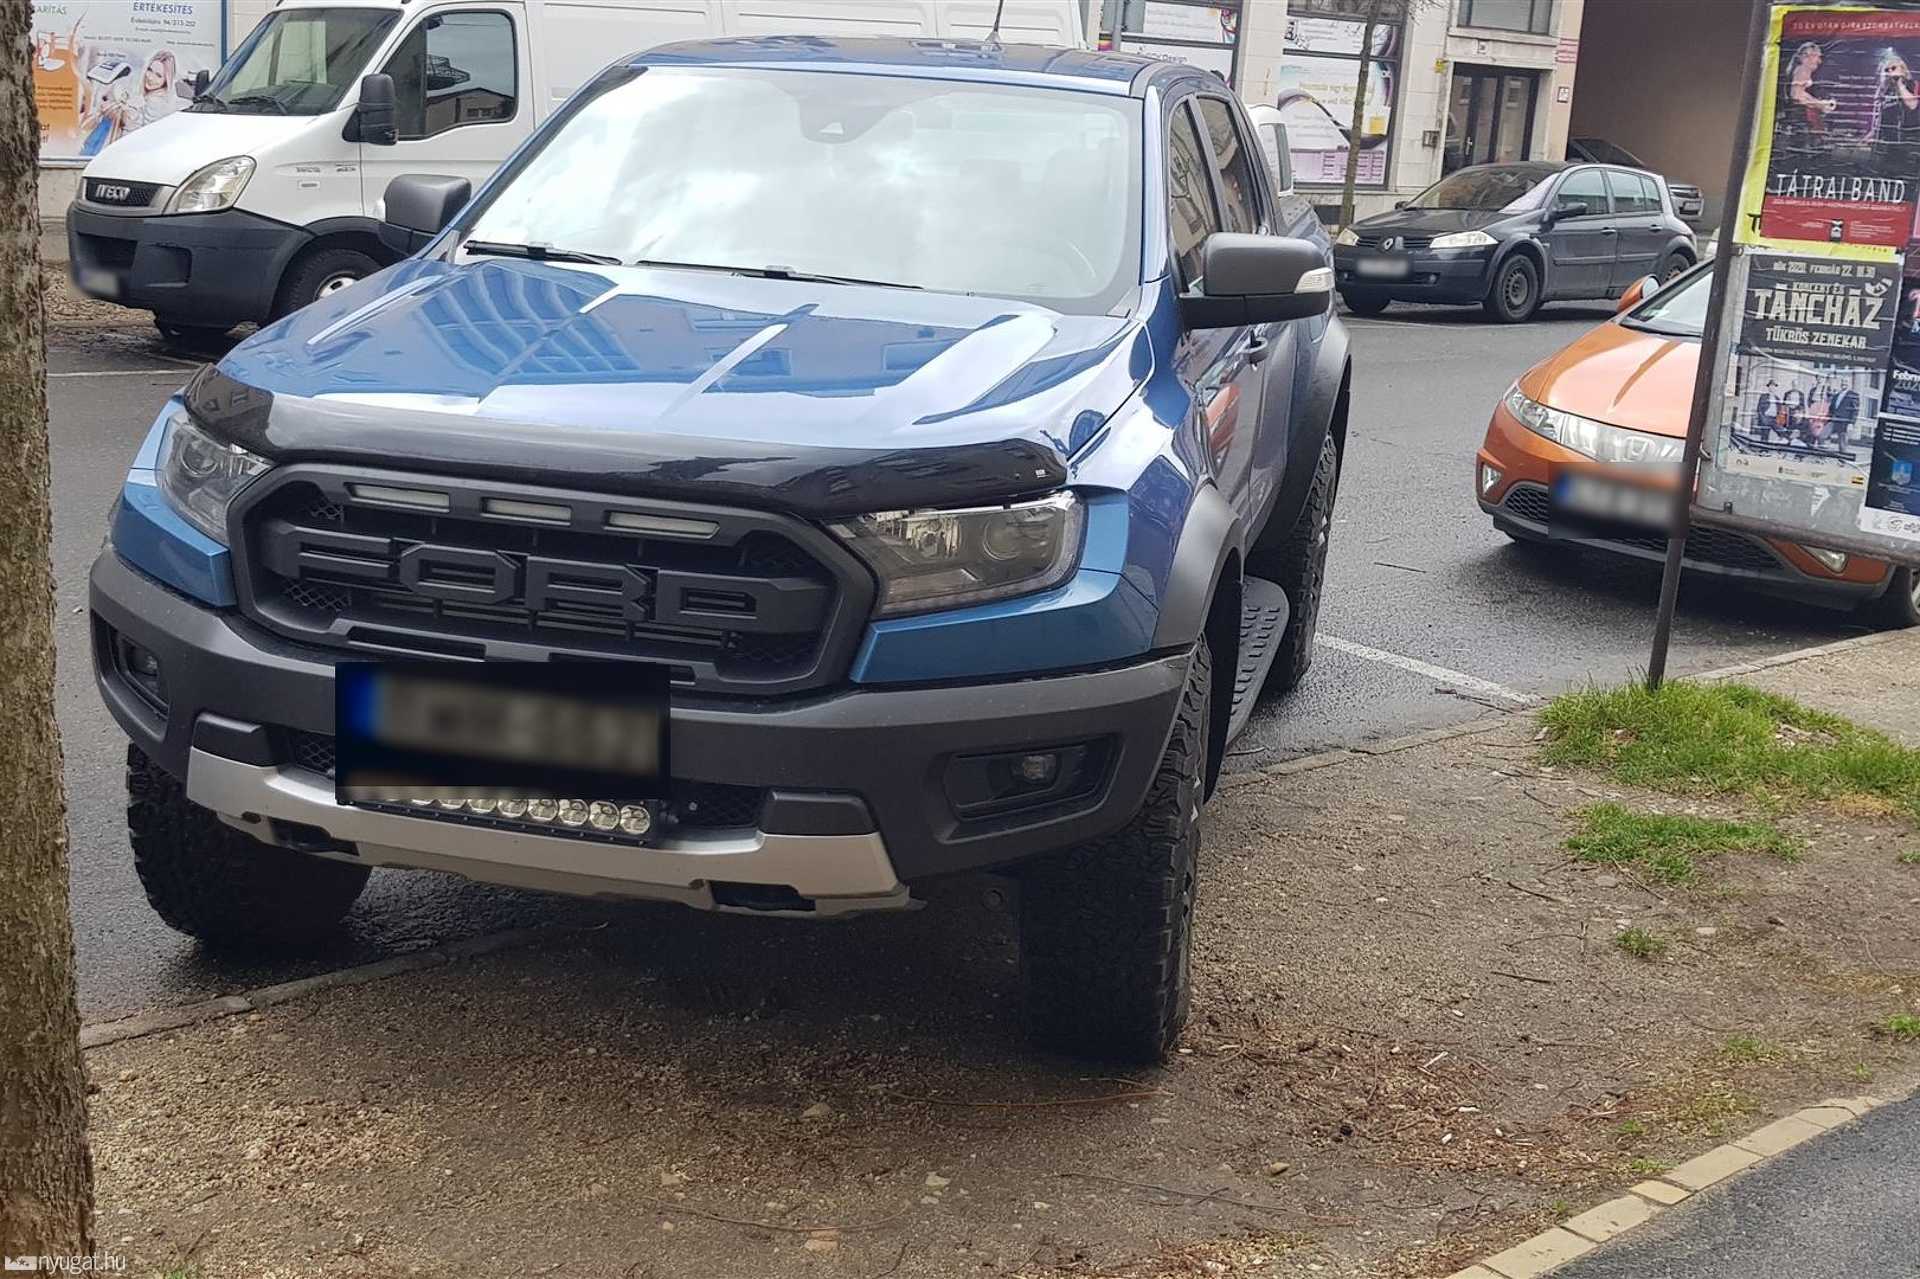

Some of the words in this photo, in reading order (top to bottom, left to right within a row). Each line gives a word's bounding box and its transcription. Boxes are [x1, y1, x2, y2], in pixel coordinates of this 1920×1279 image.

[95, 184, 131, 201] IVECO
[1776, 168, 1846, 200] TÁTRAI
[1850, 176, 1906, 203] BAND
[1754, 282, 1884, 330] TÁNCHÁZ
[1811, 332, 1868, 350] ZENEKAR
[268, 522, 828, 636] FORD
